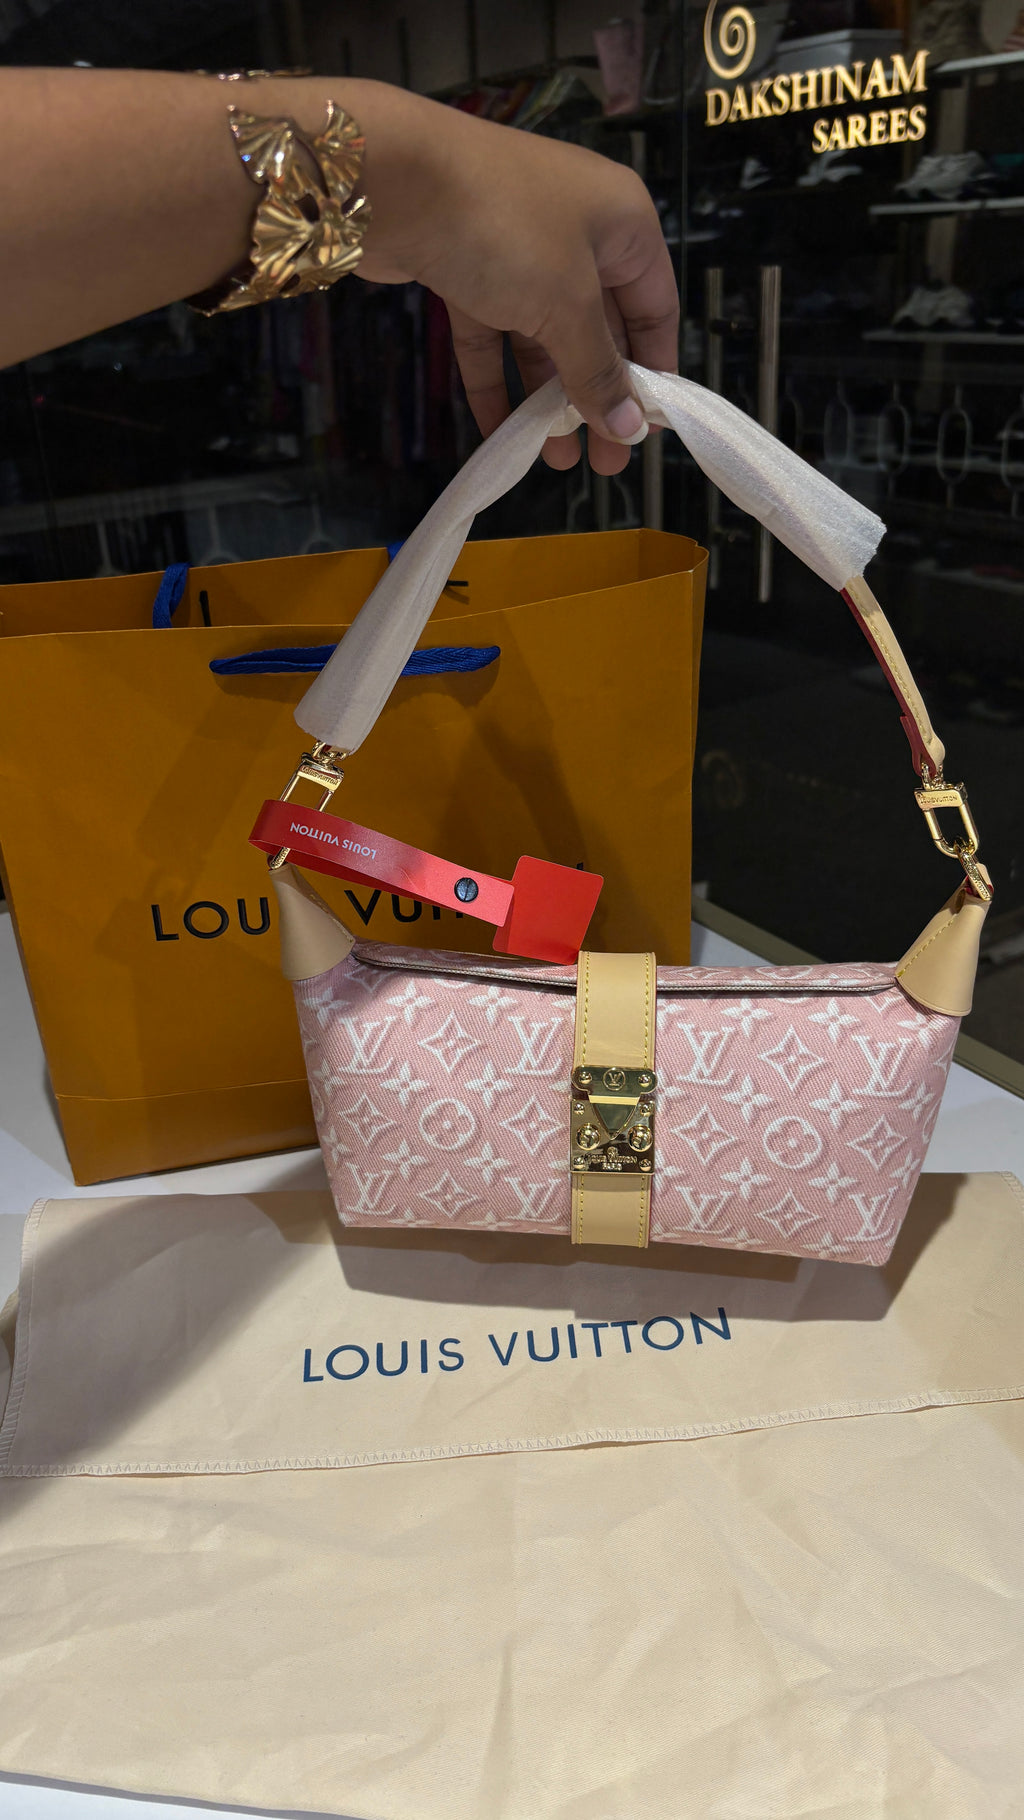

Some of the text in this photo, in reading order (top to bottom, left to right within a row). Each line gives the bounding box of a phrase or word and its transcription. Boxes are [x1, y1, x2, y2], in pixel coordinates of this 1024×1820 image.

[705, 50, 930, 127] DAKSHINAM
[812, 105, 928, 153] SAREES
[290, 822, 377, 860] LOUIS VUITTON
[151, 897, 271, 941] LOU
[303, 1306, 732, 1382] LOUIS VUITTON
